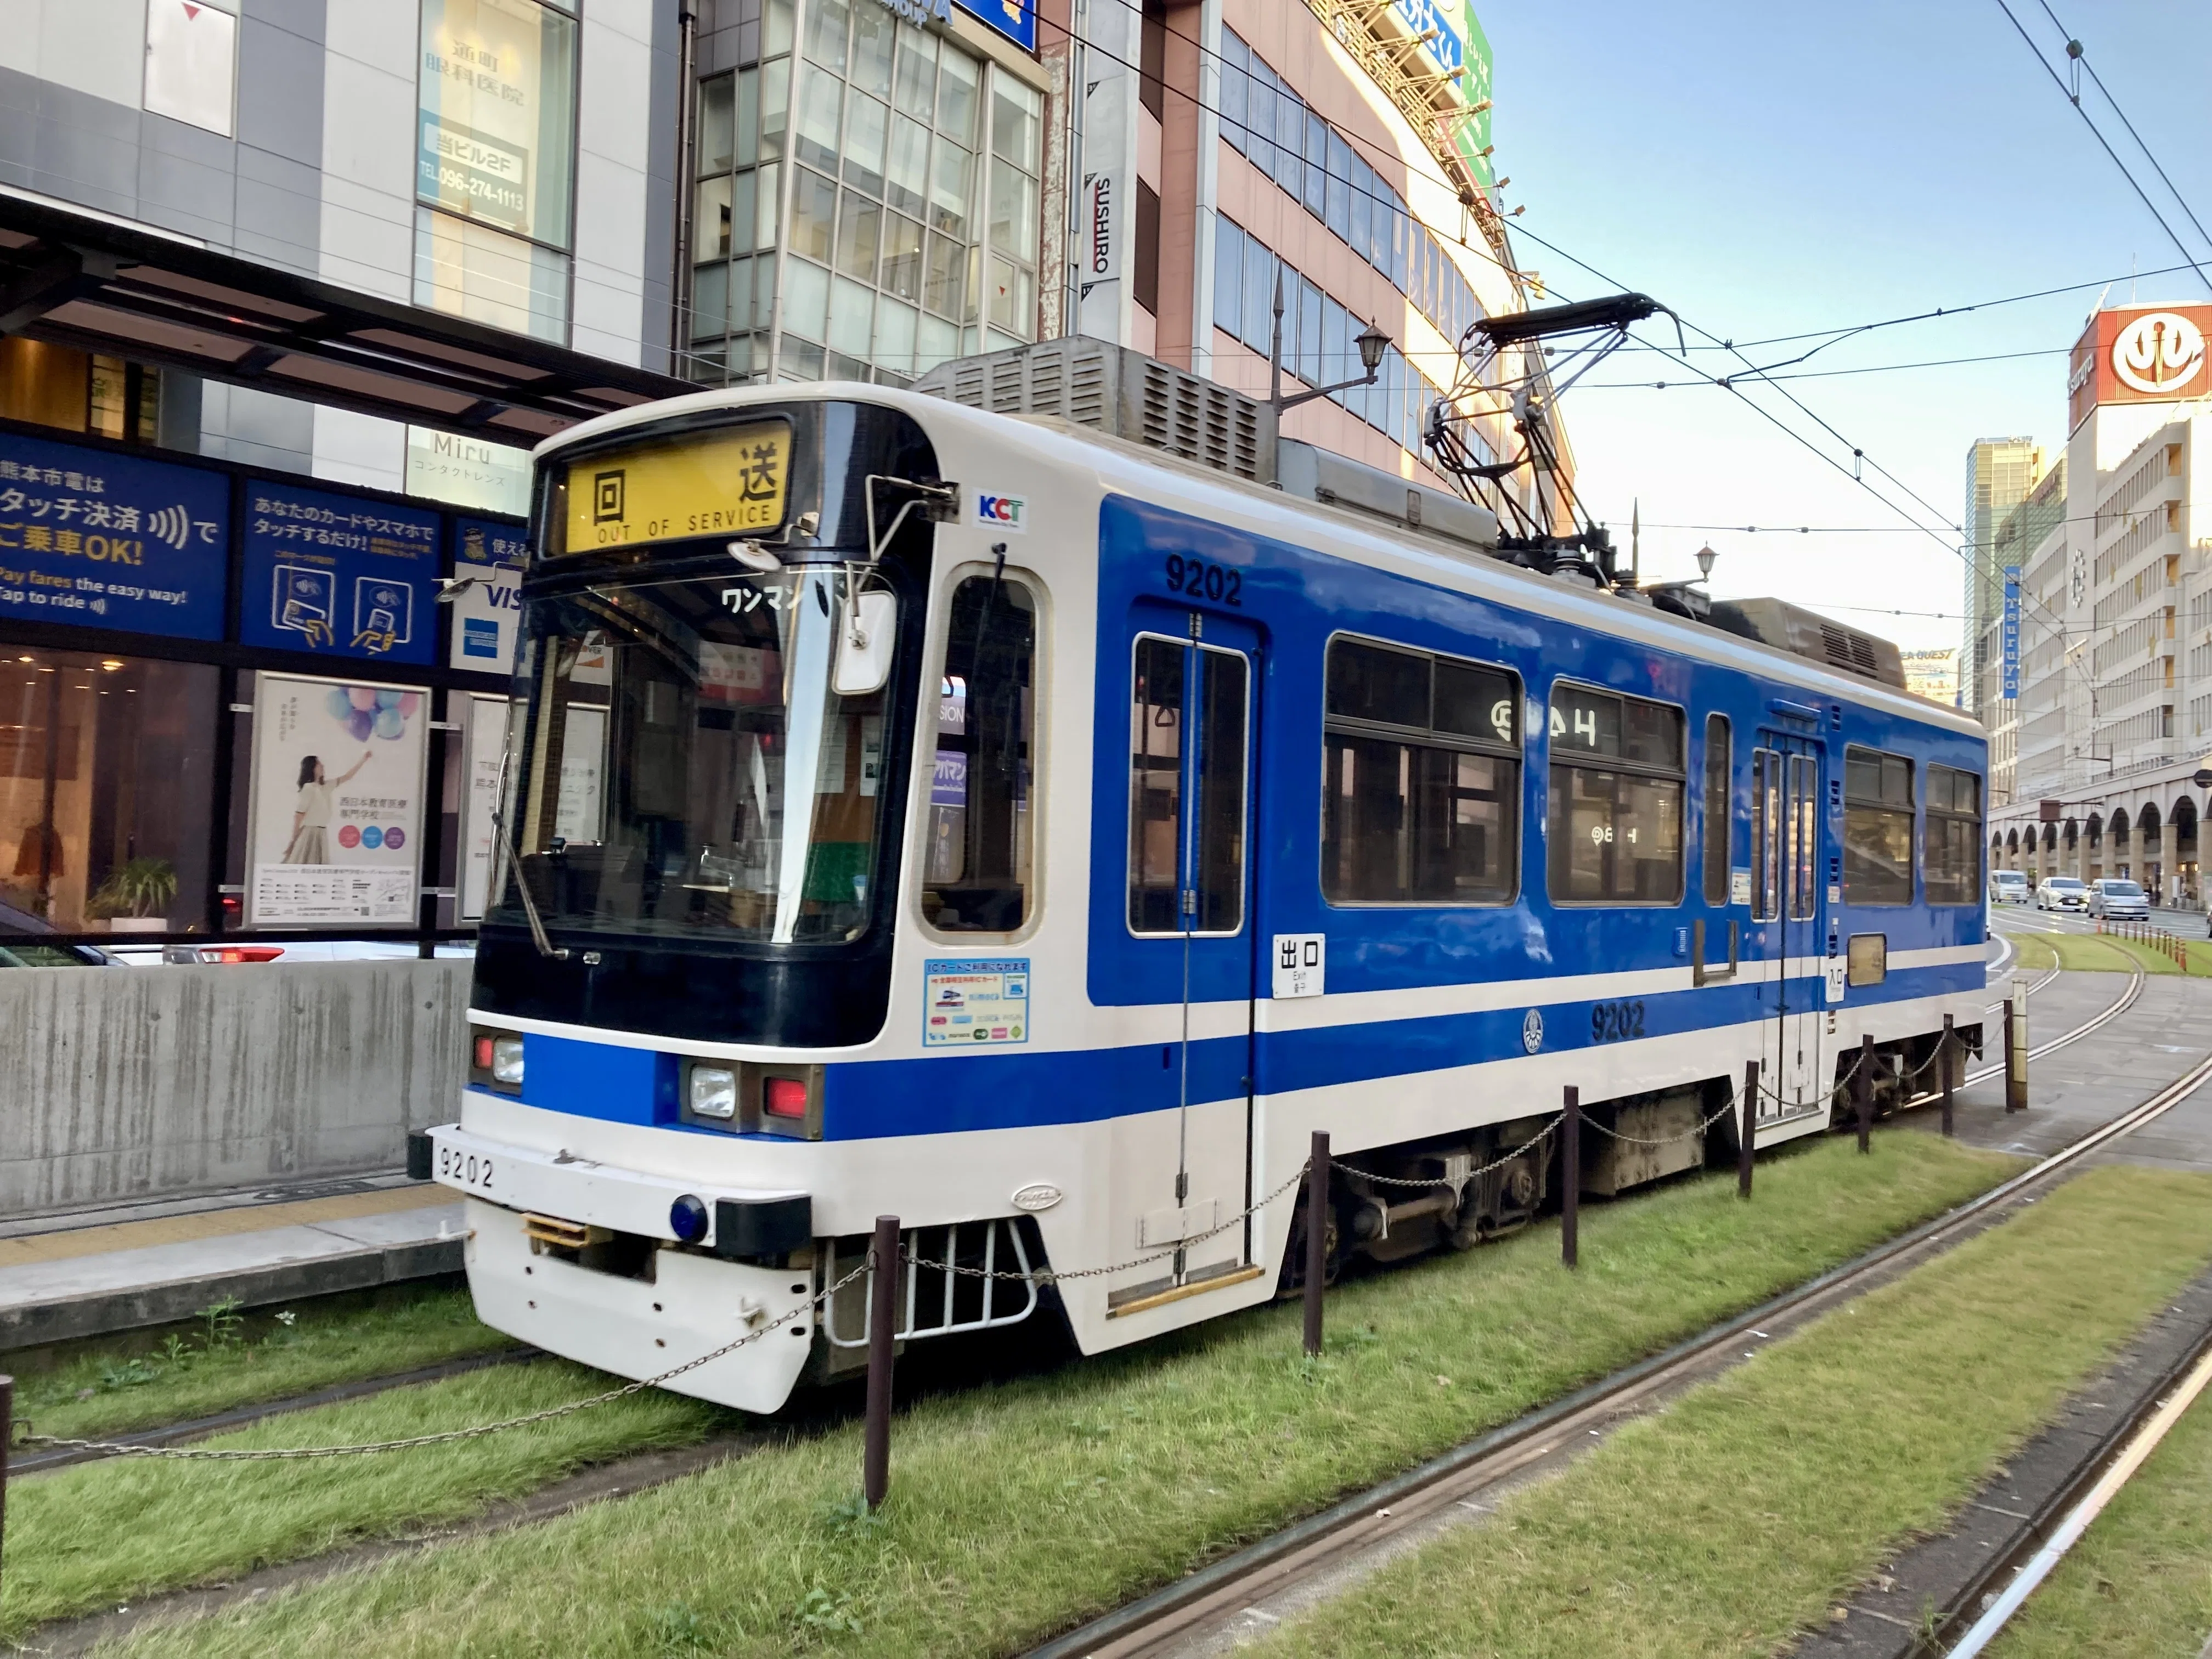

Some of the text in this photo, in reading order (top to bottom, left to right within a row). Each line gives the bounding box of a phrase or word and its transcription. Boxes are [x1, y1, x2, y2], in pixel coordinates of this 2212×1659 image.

[453, 39, 499, 72] 通町
[425, 52, 524, 106] 眼科医院
[436, 133, 512, 172] 当ビル2F
[1097, 177, 1110, 274] SUSHIRO
[434, 433, 491, 464] Miru
[415, 460, 506, 487] コンタクトレンズ
[0, 488, 218, 543] タッチ決済 で
[254, 497, 434, 540] あなたのカードやスマホで
[598, 504, 770, 544] OUT OF SERVICE
[980, 495, 1024, 522] KCT
[29, 570, 72, 588] fares
[76, 578, 105, 592] the
[108, 583, 145, 601] easy
[149, 590, 188, 605] way!
[1166, 553, 1242, 607] 9202
[29, 590, 47, 604] to
[51, 592, 86, 609] ride
[722, 585, 806, 614] ワンマン
[1917, 648, 1956, 661] QUEST
[2005, 597, 2017, 690] Tsuruya
[1282, 940, 1318, 969] 出口
[1830, 969, 1842, 985] 入口
[1592, 1000, 1645, 1041] 9202
[441, 1147, 492, 1188] 9202
